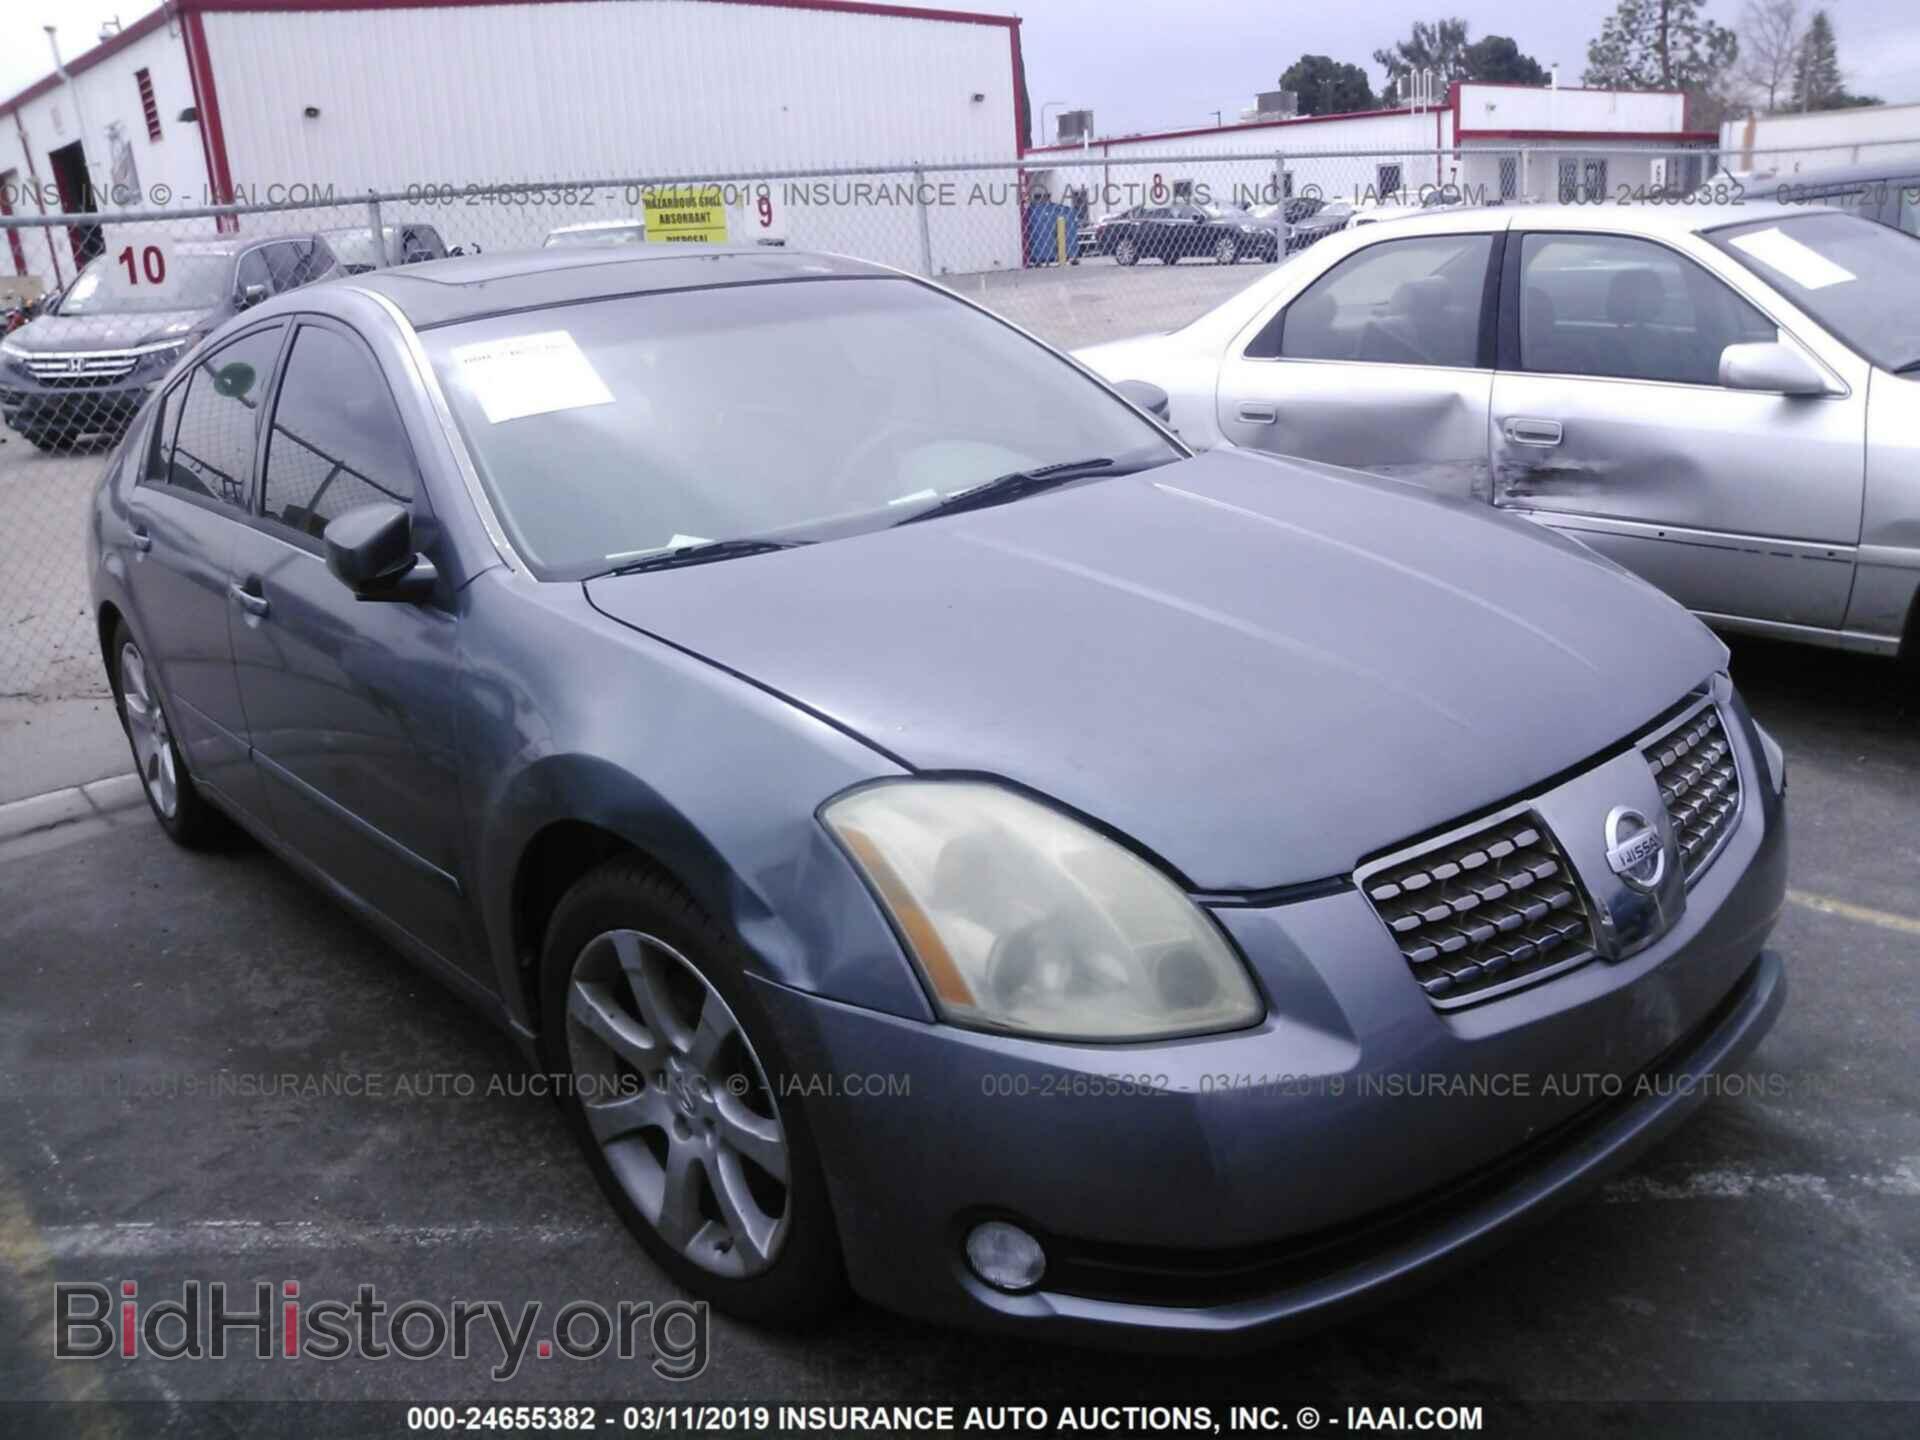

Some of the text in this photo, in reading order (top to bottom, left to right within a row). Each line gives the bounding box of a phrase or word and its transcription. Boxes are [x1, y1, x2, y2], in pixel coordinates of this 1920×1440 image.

[1153, 173, 1163, 198] 8
[757, 196, 773, 227] 9
[118, 245, 166, 286] 10
[1619, 833, 1659, 867] NISSA
